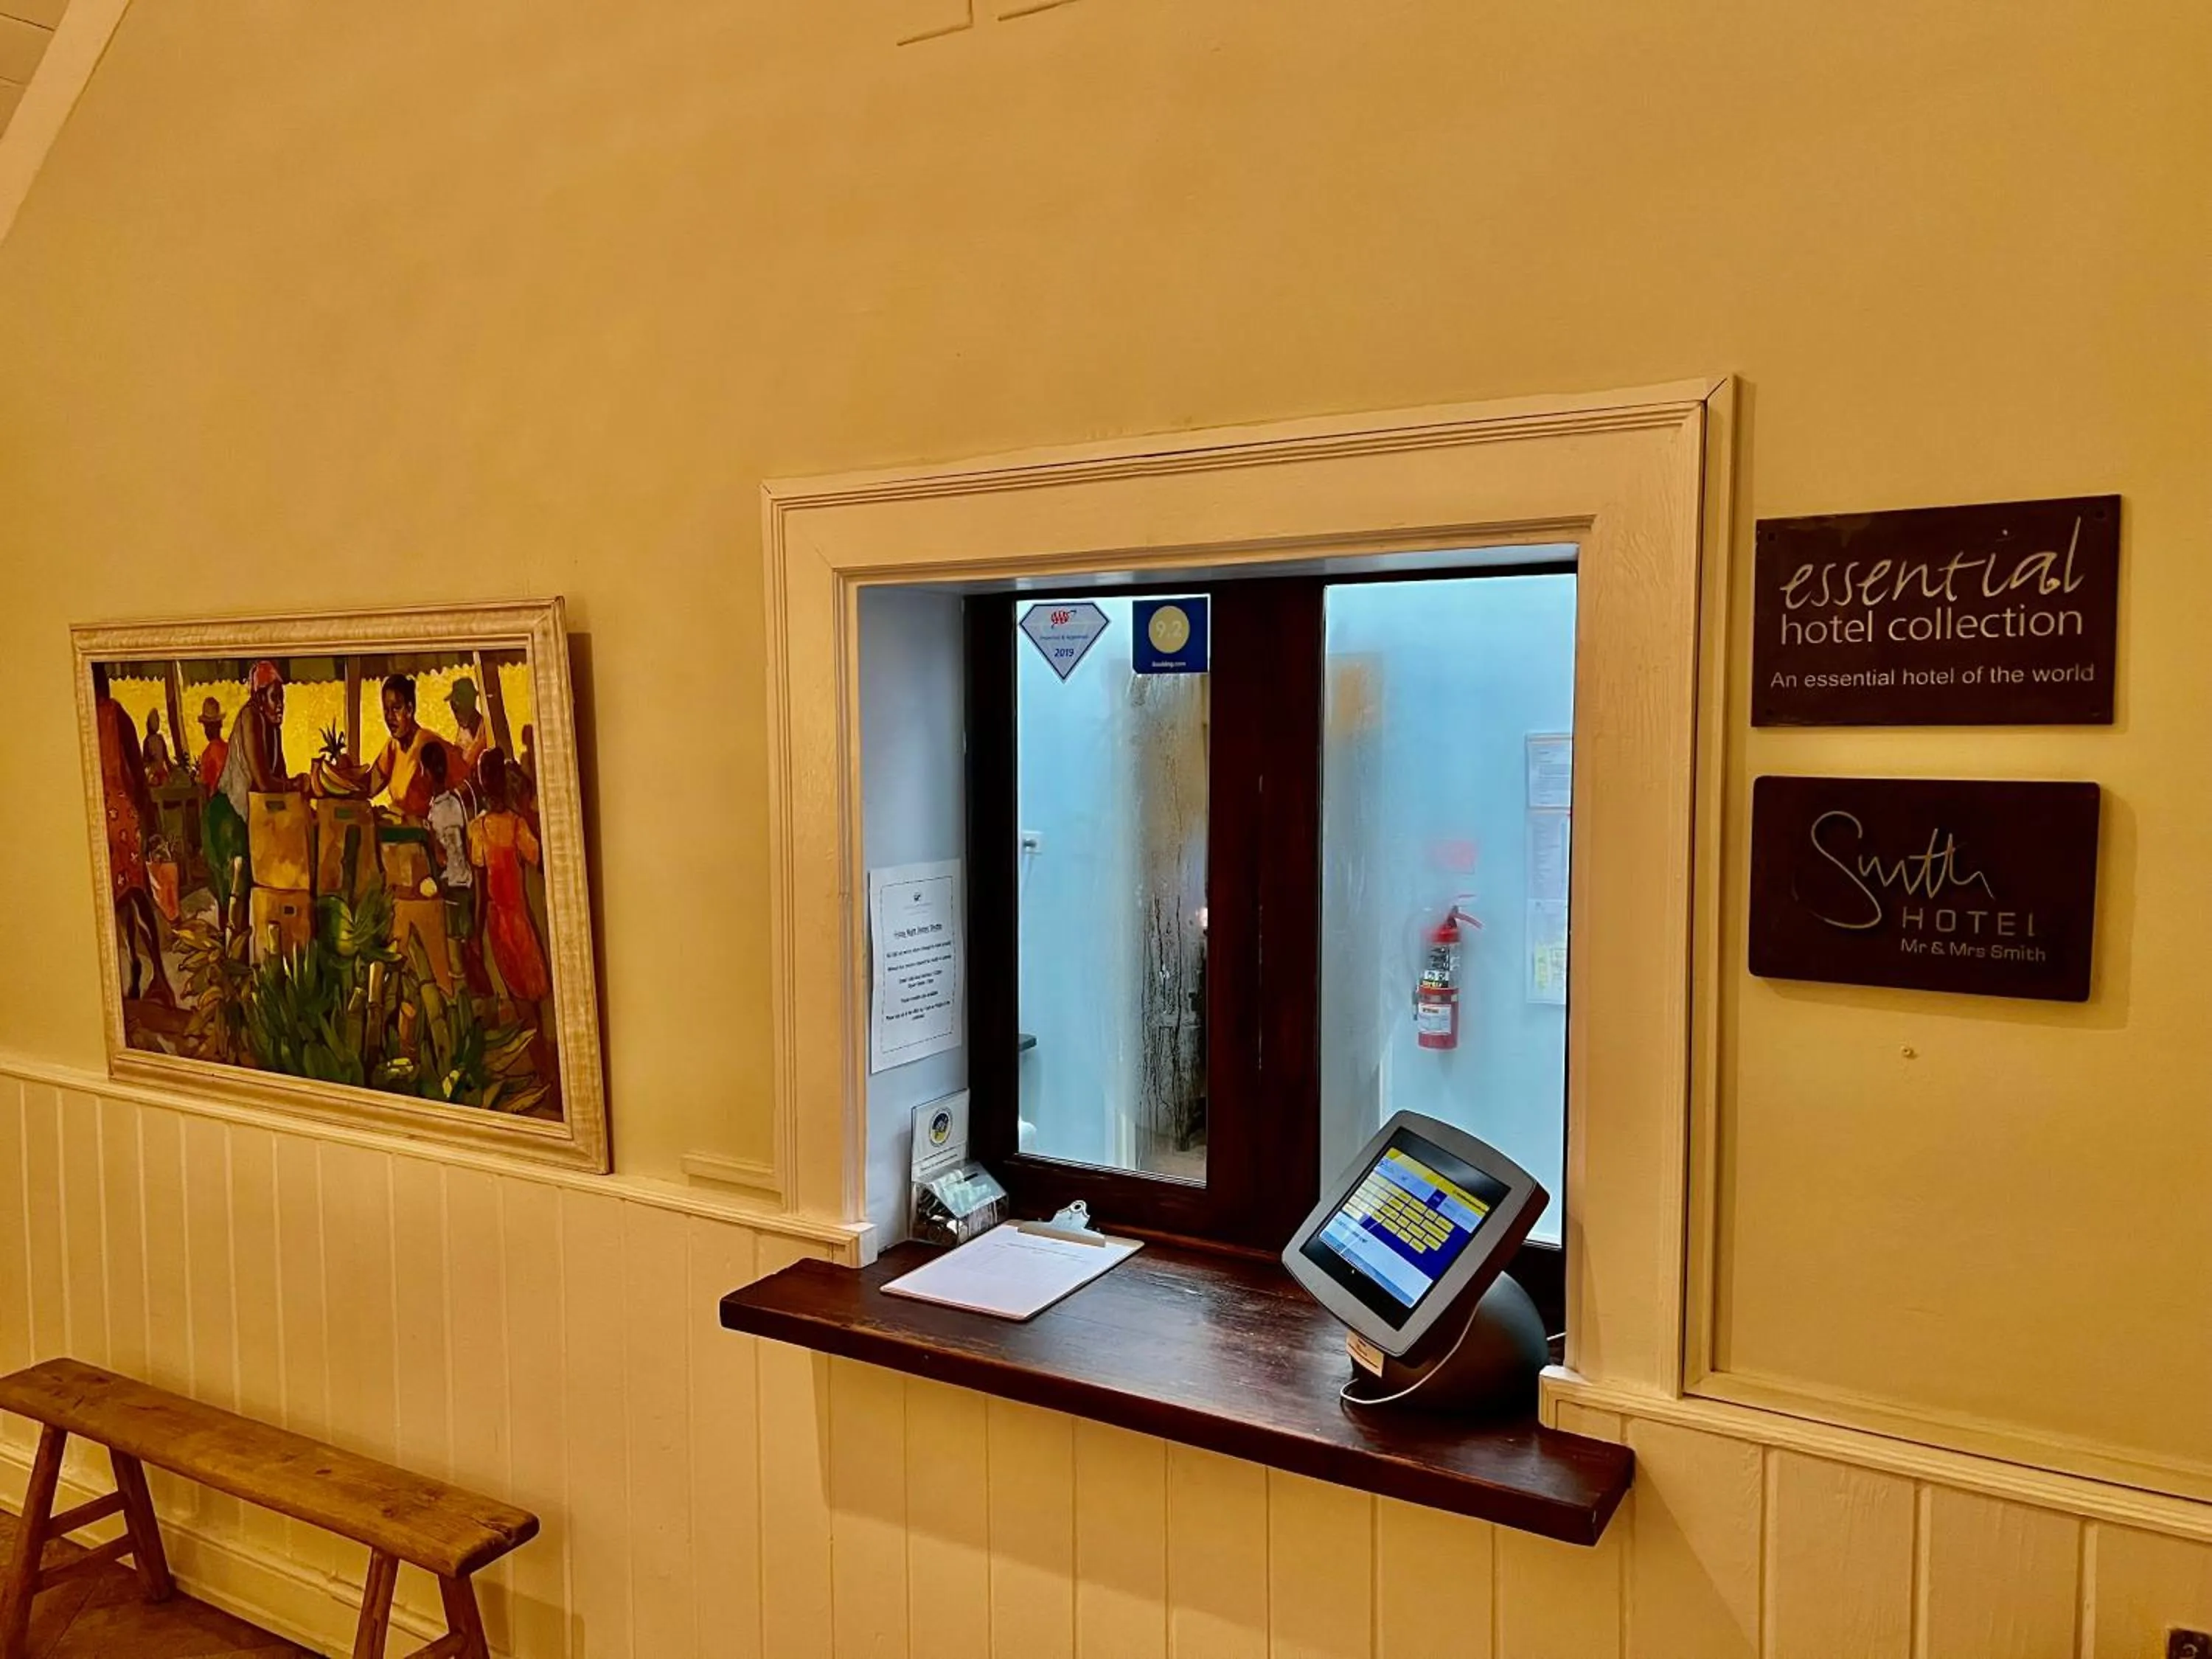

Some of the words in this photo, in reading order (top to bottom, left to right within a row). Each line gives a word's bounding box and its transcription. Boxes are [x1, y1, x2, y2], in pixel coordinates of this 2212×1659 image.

[1780, 515, 2086, 611] essential
[1780, 610, 1874, 646] hotel
[1888, 603, 2083, 642] collection
[1054, 648, 1074, 658] 2019
[1770, 671, 1798, 689] An
[1804, 667, 1896, 688] essential
[1902, 666, 1955, 686] hotel
[1961, 665, 1985, 684] of
[1989, 665, 2024, 684] the
[2032, 664, 2095, 683] world
[1900, 937, 1928, 954] Mr
[1930, 941, 1946, 956] &
[1949, 942, 1986, 959] Mrs
[1990, 945, 2047, 962] Smith
